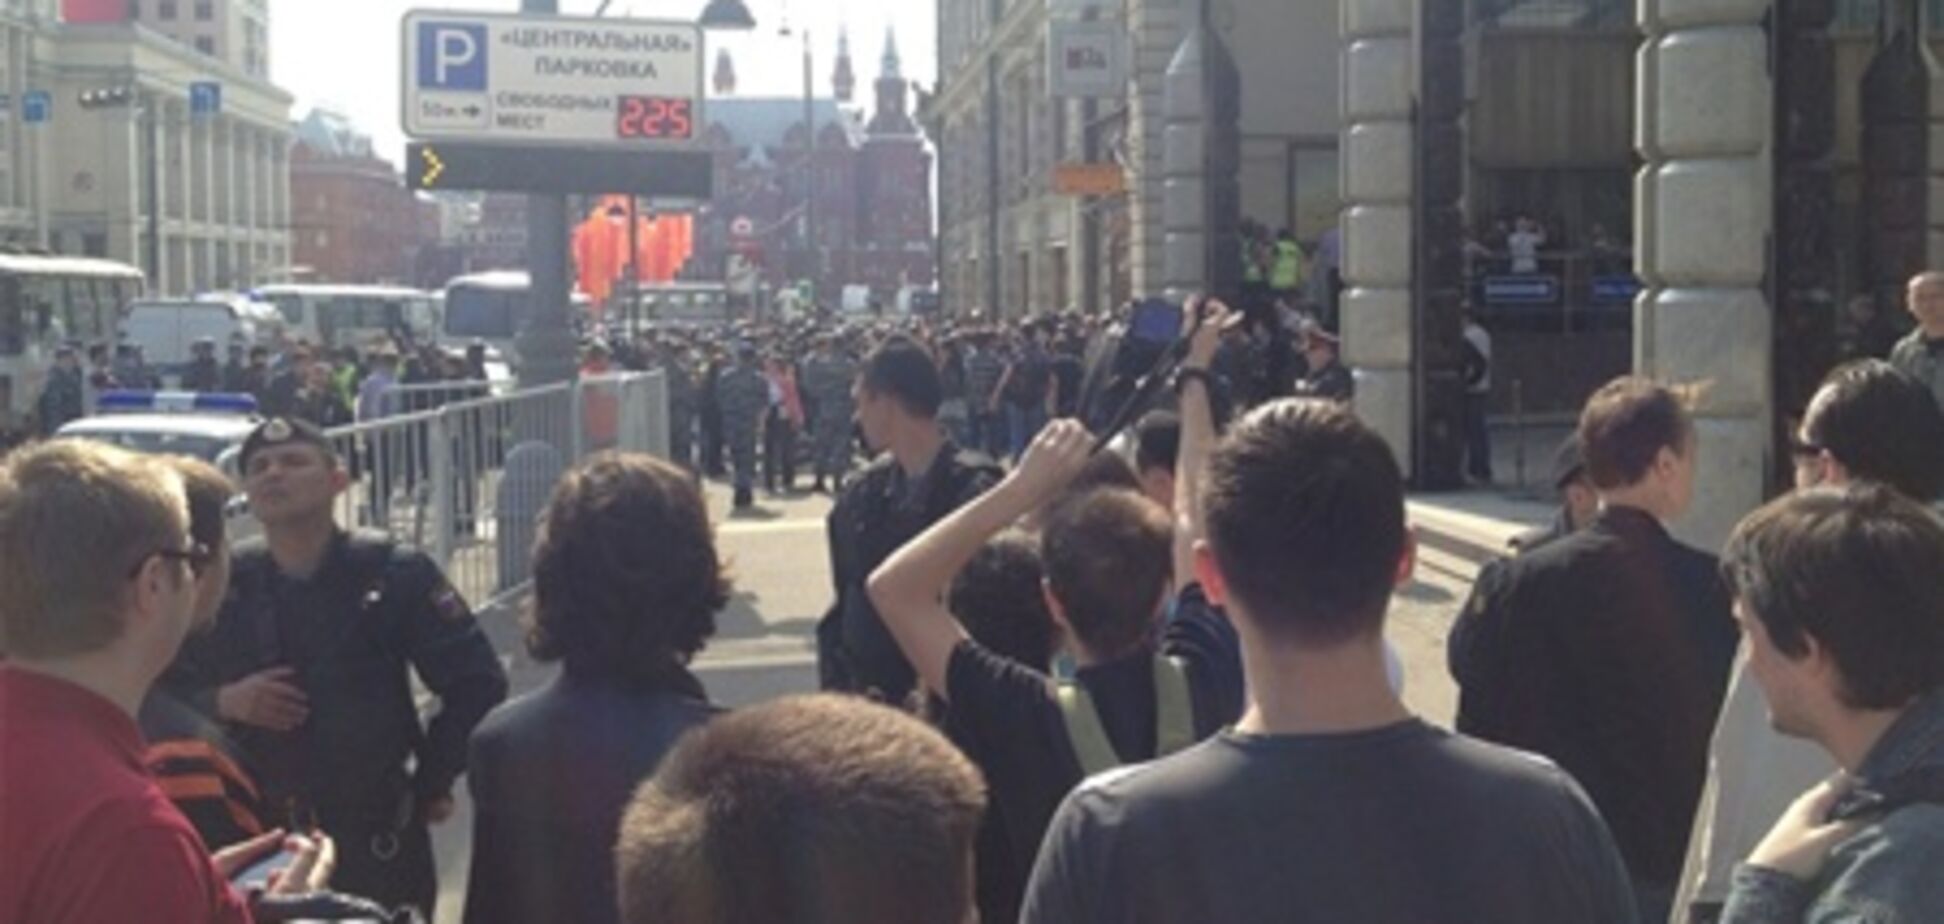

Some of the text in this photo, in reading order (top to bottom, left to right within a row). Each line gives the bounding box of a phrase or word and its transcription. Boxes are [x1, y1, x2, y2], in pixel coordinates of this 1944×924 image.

[500, 28, 692, 51] «ЦЕНТРАЛЬНАЯ»
[435, 30, 476, 84] P
[535, 56, 658, 79] ПАРКОВКА
[496, 91, 611, 111] СВОБОДНЫХ
[496, 114, 546, 130] МЕСТ
[619, 99, 690, 136] 225
